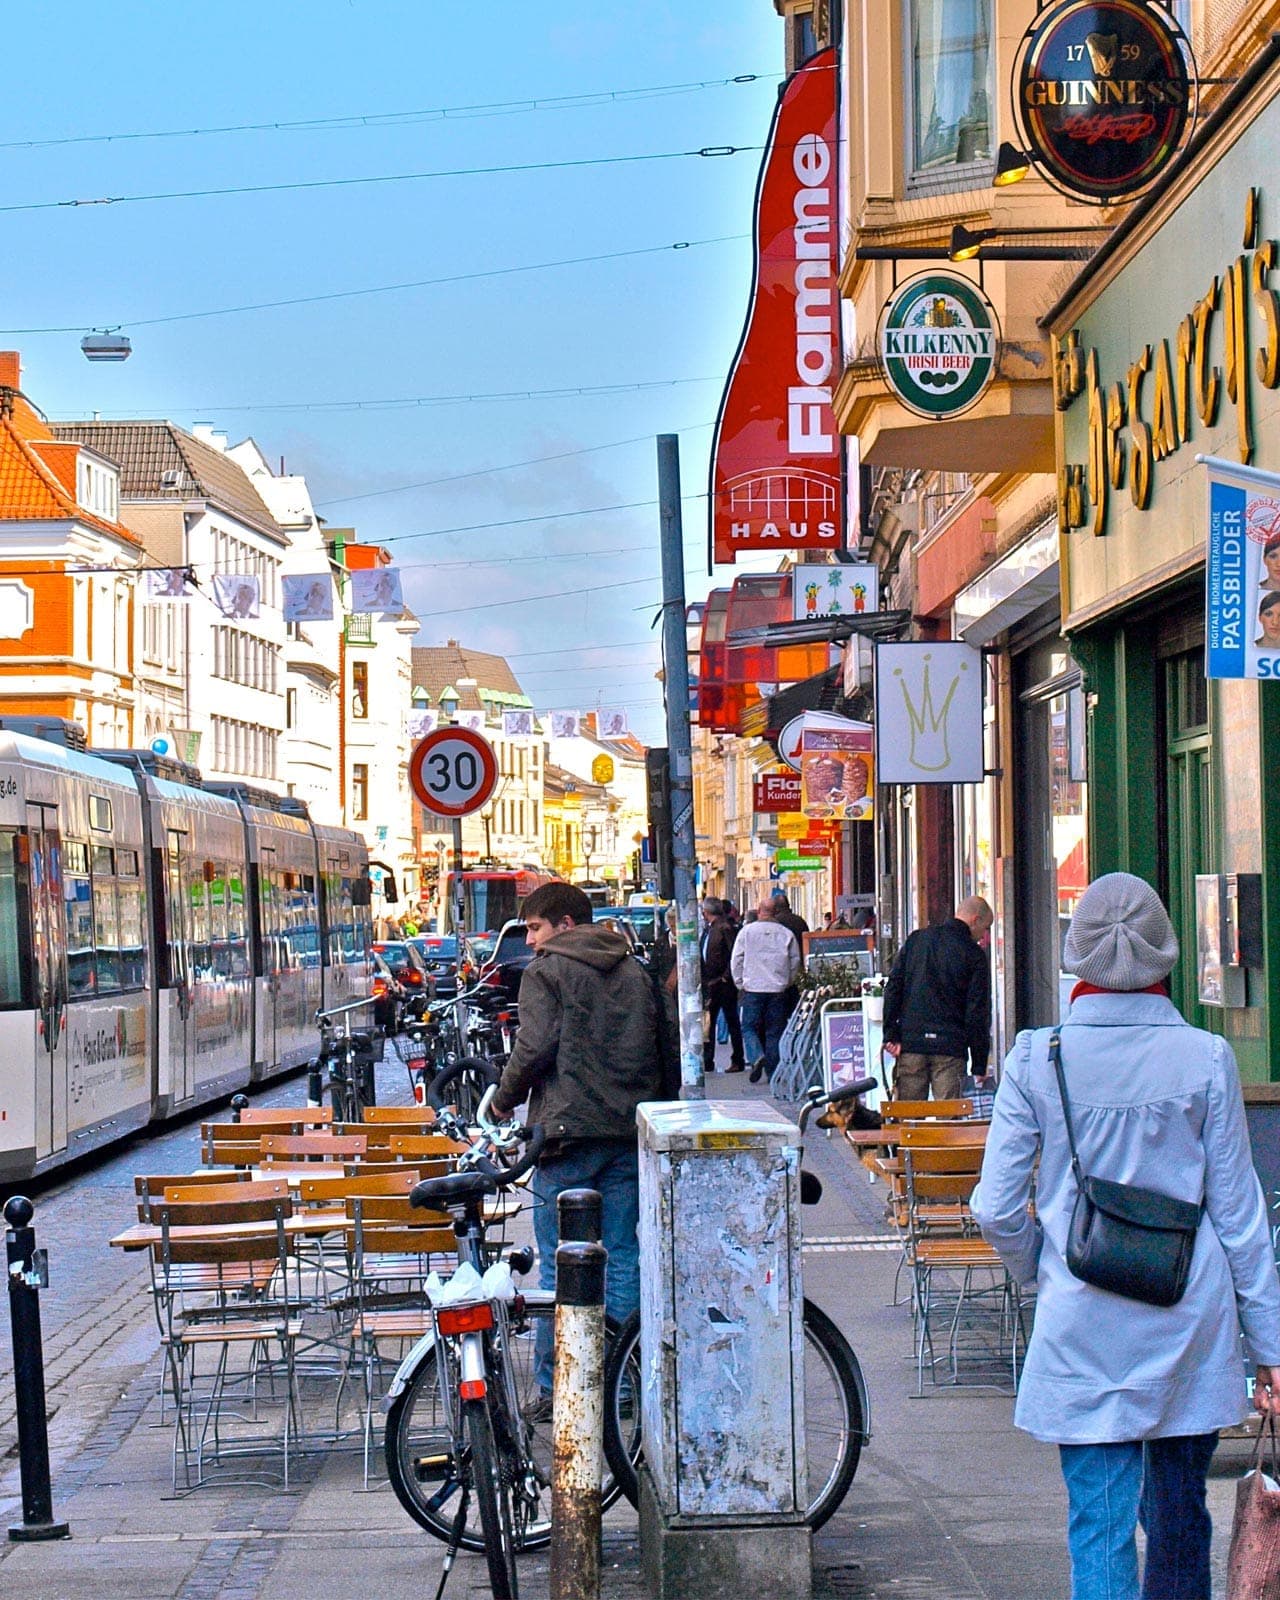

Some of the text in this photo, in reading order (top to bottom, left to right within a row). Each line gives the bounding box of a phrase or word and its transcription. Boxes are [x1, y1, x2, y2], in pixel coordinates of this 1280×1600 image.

[1066, 44, 1141, 62] 17 59
[1024, 79, 1184, 106] GUINNESS
[786, 132, 834, 454] Flamme
[885, 331, 993, 354] KILKENNY
[908, 355, 971, 369] IRISH BEER
[730, 522, 836, 538] HAUS
[1211, 511, 1221, 649] DIGITALE BIOMETRIETAUGLICHE
[1222, 510, 1241, 649] PASSBILDER
[428, 751, 477, 792] 30
[767, 778, 801, 790] Fla
